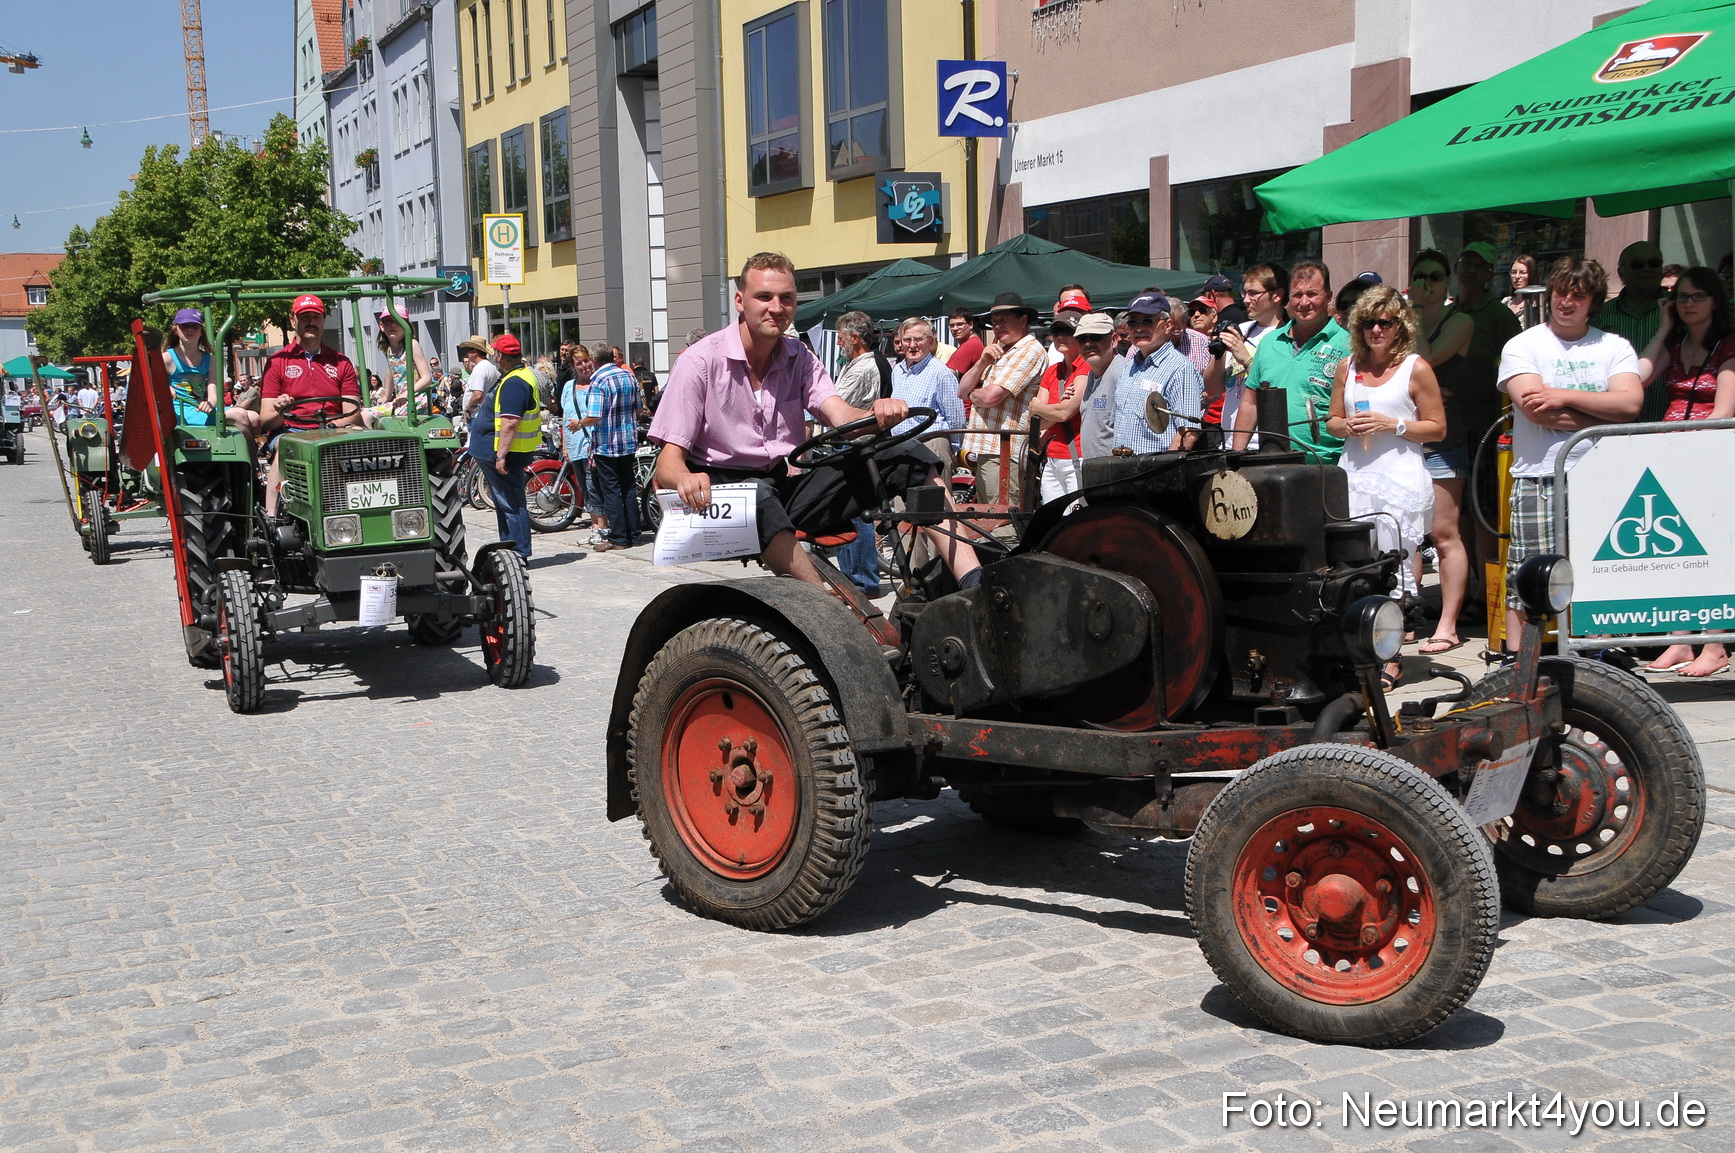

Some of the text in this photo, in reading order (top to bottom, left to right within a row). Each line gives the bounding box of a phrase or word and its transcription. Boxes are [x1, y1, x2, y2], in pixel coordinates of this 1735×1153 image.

[1608, 67, 1650, 80] 1628
[1504, 76, 1722, 119] Neumarkter
[1445, 90, 1735, 147] Lammsbräu
[1014, 149, 1064, 173] Unterer Markt 15
[903, 191, 926, 220] G2
[497, 225, 510, 243] H
[339, 454, 404, 473] FENDT
[362, 482, 383, 495] NM
[350, 493, 397, 509] SW 76
[1211, 487, 1252, 523] 6 km
[699, 503, 732, 520] 402
[1592, 565, 1609, 574] Jura
[1611, 563, 1649, 573] Gebäude
[1682, 560, 1709, 569] GmbH
[1591, 603, 1735, 627] www.jura-geb
